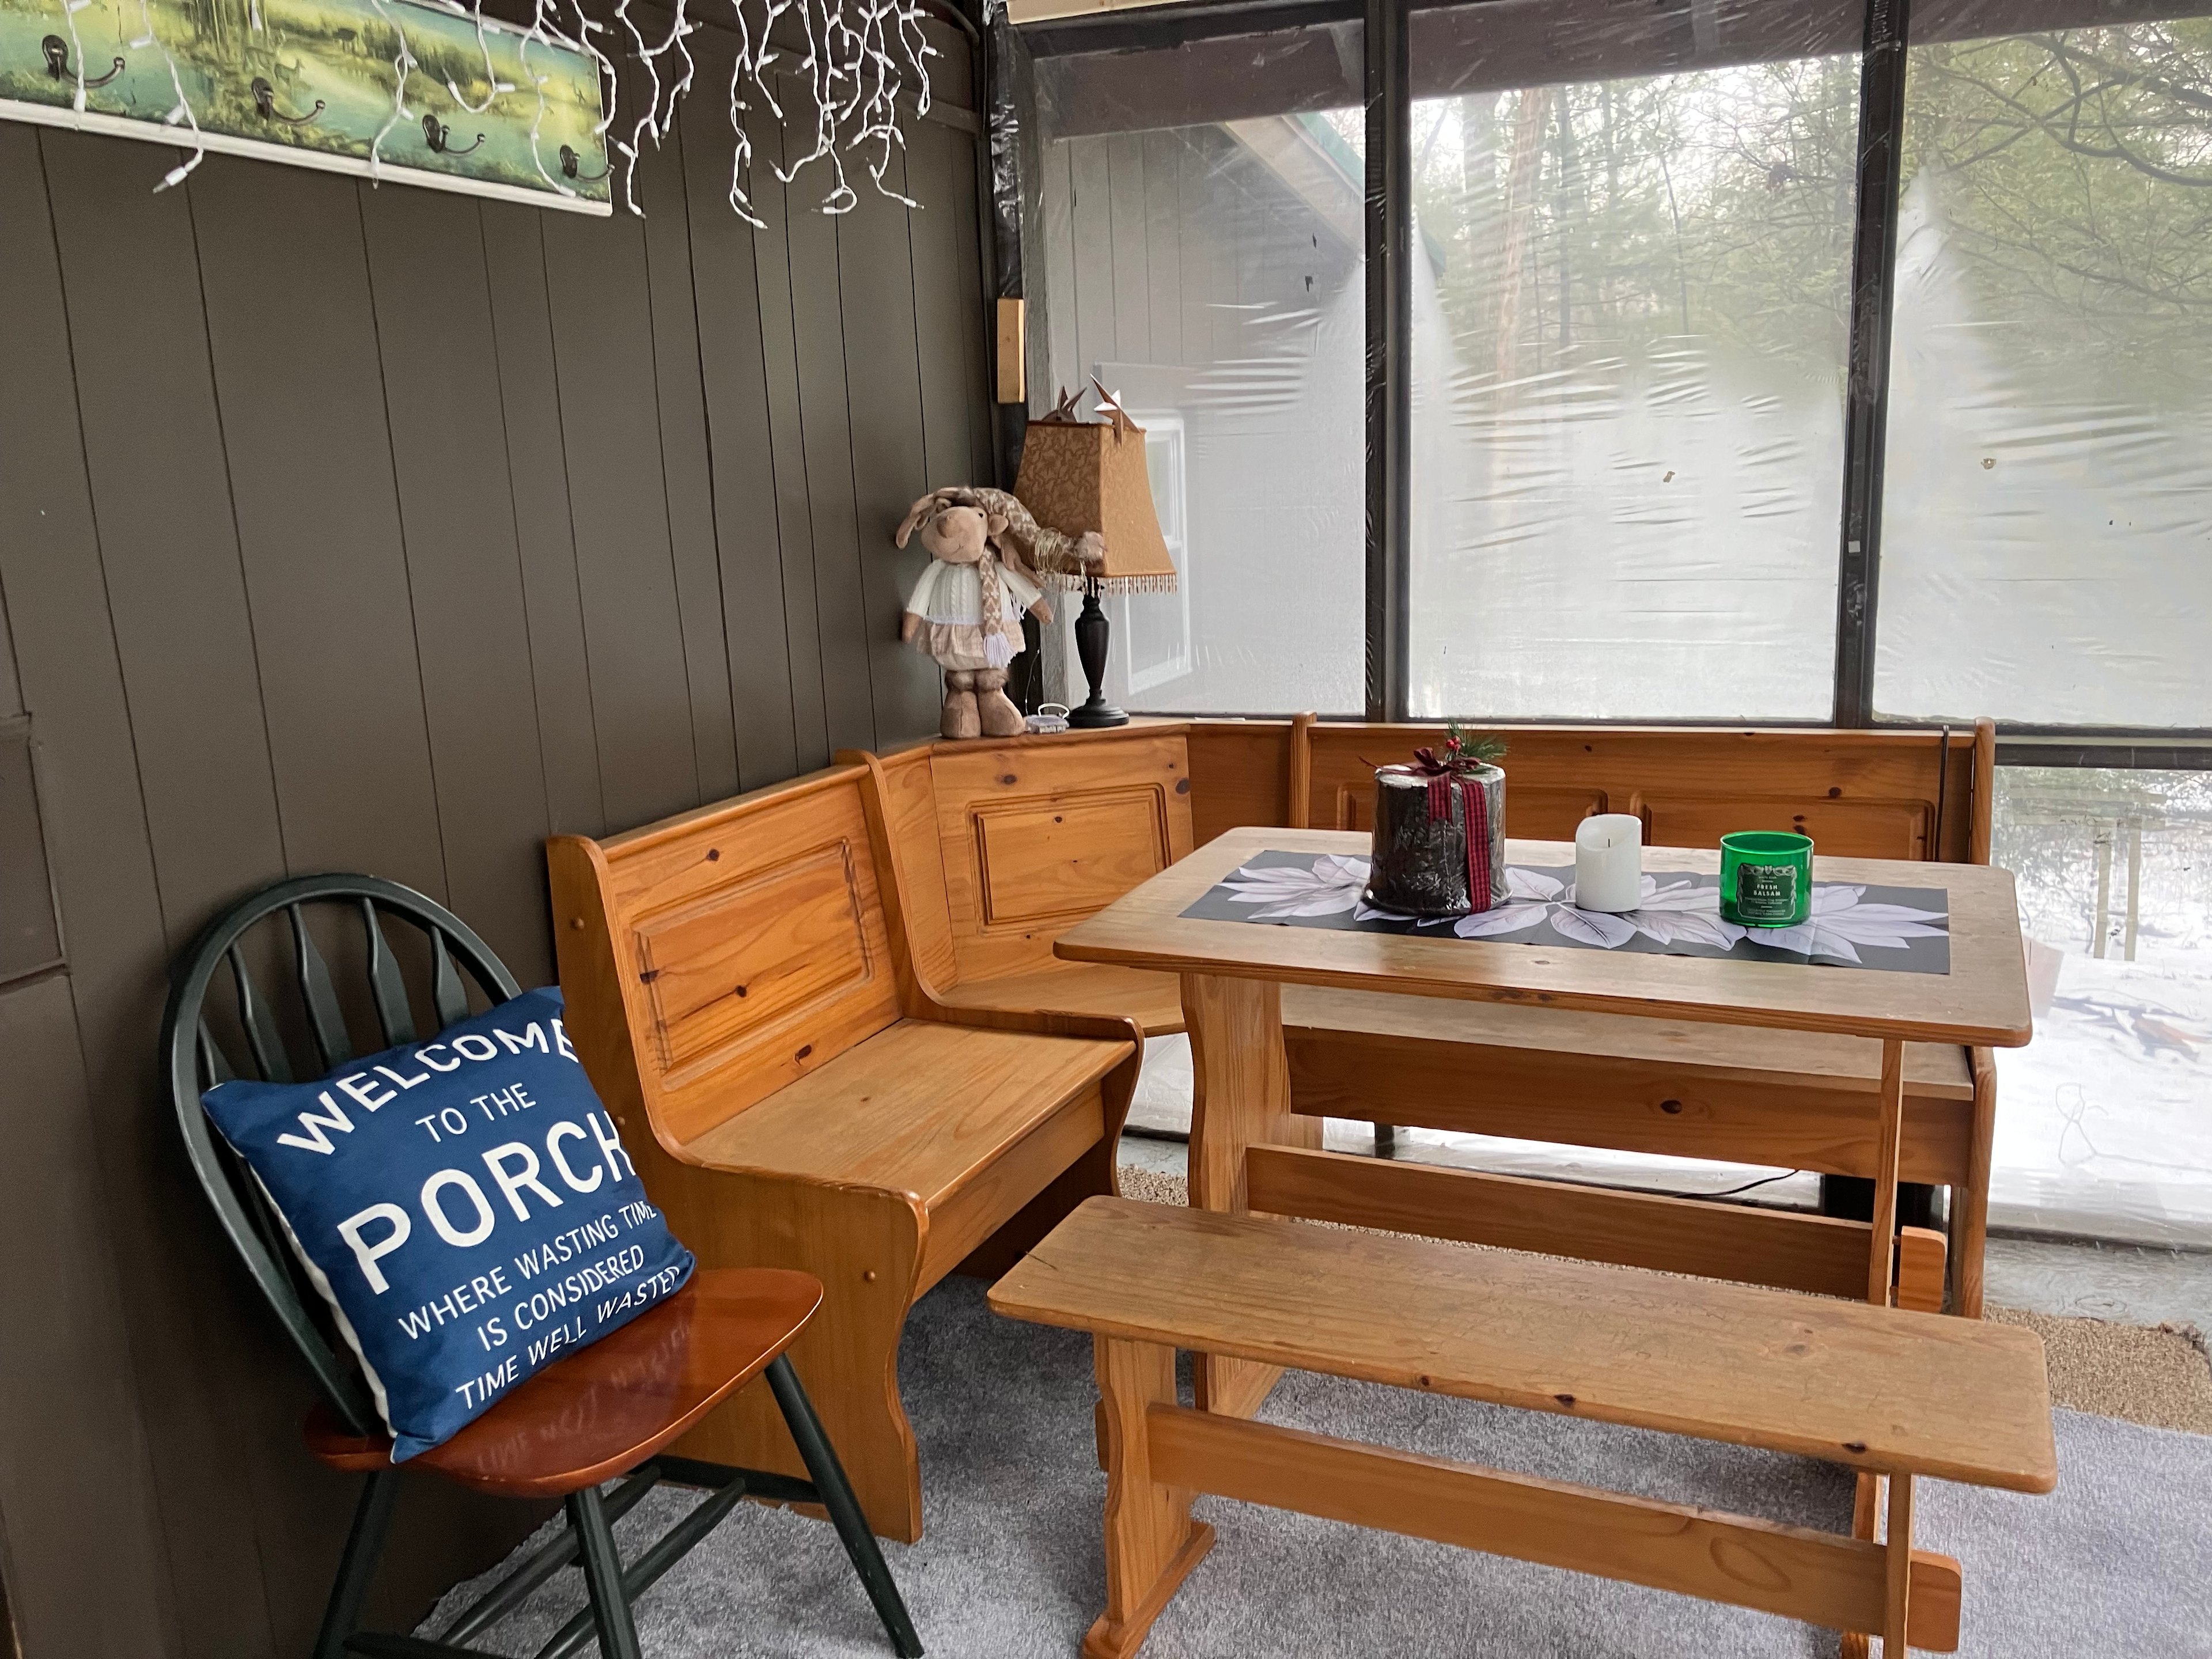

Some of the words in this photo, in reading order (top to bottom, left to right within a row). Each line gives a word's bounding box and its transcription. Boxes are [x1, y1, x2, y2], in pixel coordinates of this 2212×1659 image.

[277, 1019, 579, 1155] WELCOME
[415, 1107, 467, 1143] TO
[470, 1082, 536, 1121] THE
[336, 1110, 637, 1295] PORCH
[398, 1266, 512, 1340] WHERE
[514, 1214, 619, 1280] WASTING
[477, 1317, 508, 1351] IS
[514, 1244, 644, 1330] CONSIDERED
[455, 1354, 520, 1410] TIME
[527, 1316, 587, 1366] WELL
